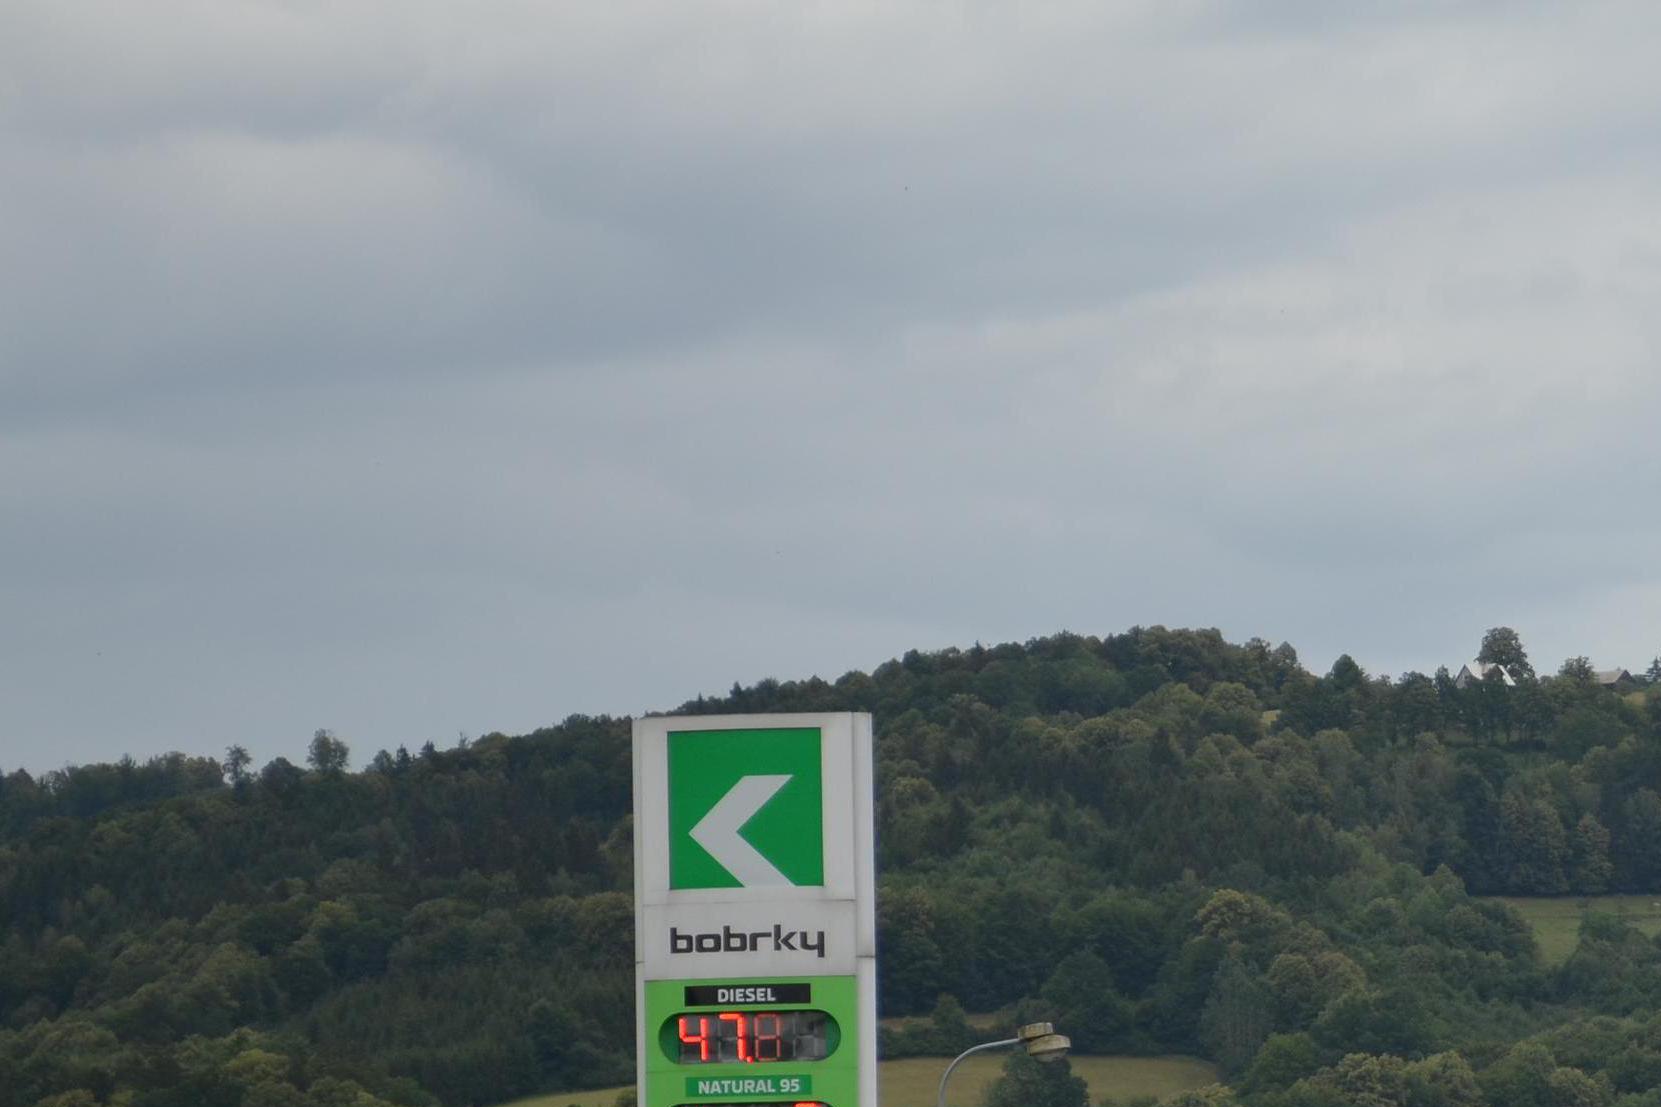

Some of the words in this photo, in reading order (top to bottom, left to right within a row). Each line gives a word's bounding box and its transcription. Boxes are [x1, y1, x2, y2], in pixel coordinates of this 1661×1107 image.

[669, 924, 825, 958] bobrky
[717, 988, 776, 1003] DIESEL
[698, 1079, 775, 1094] NATURAL
[780, 1078, 800, 1093] 95
